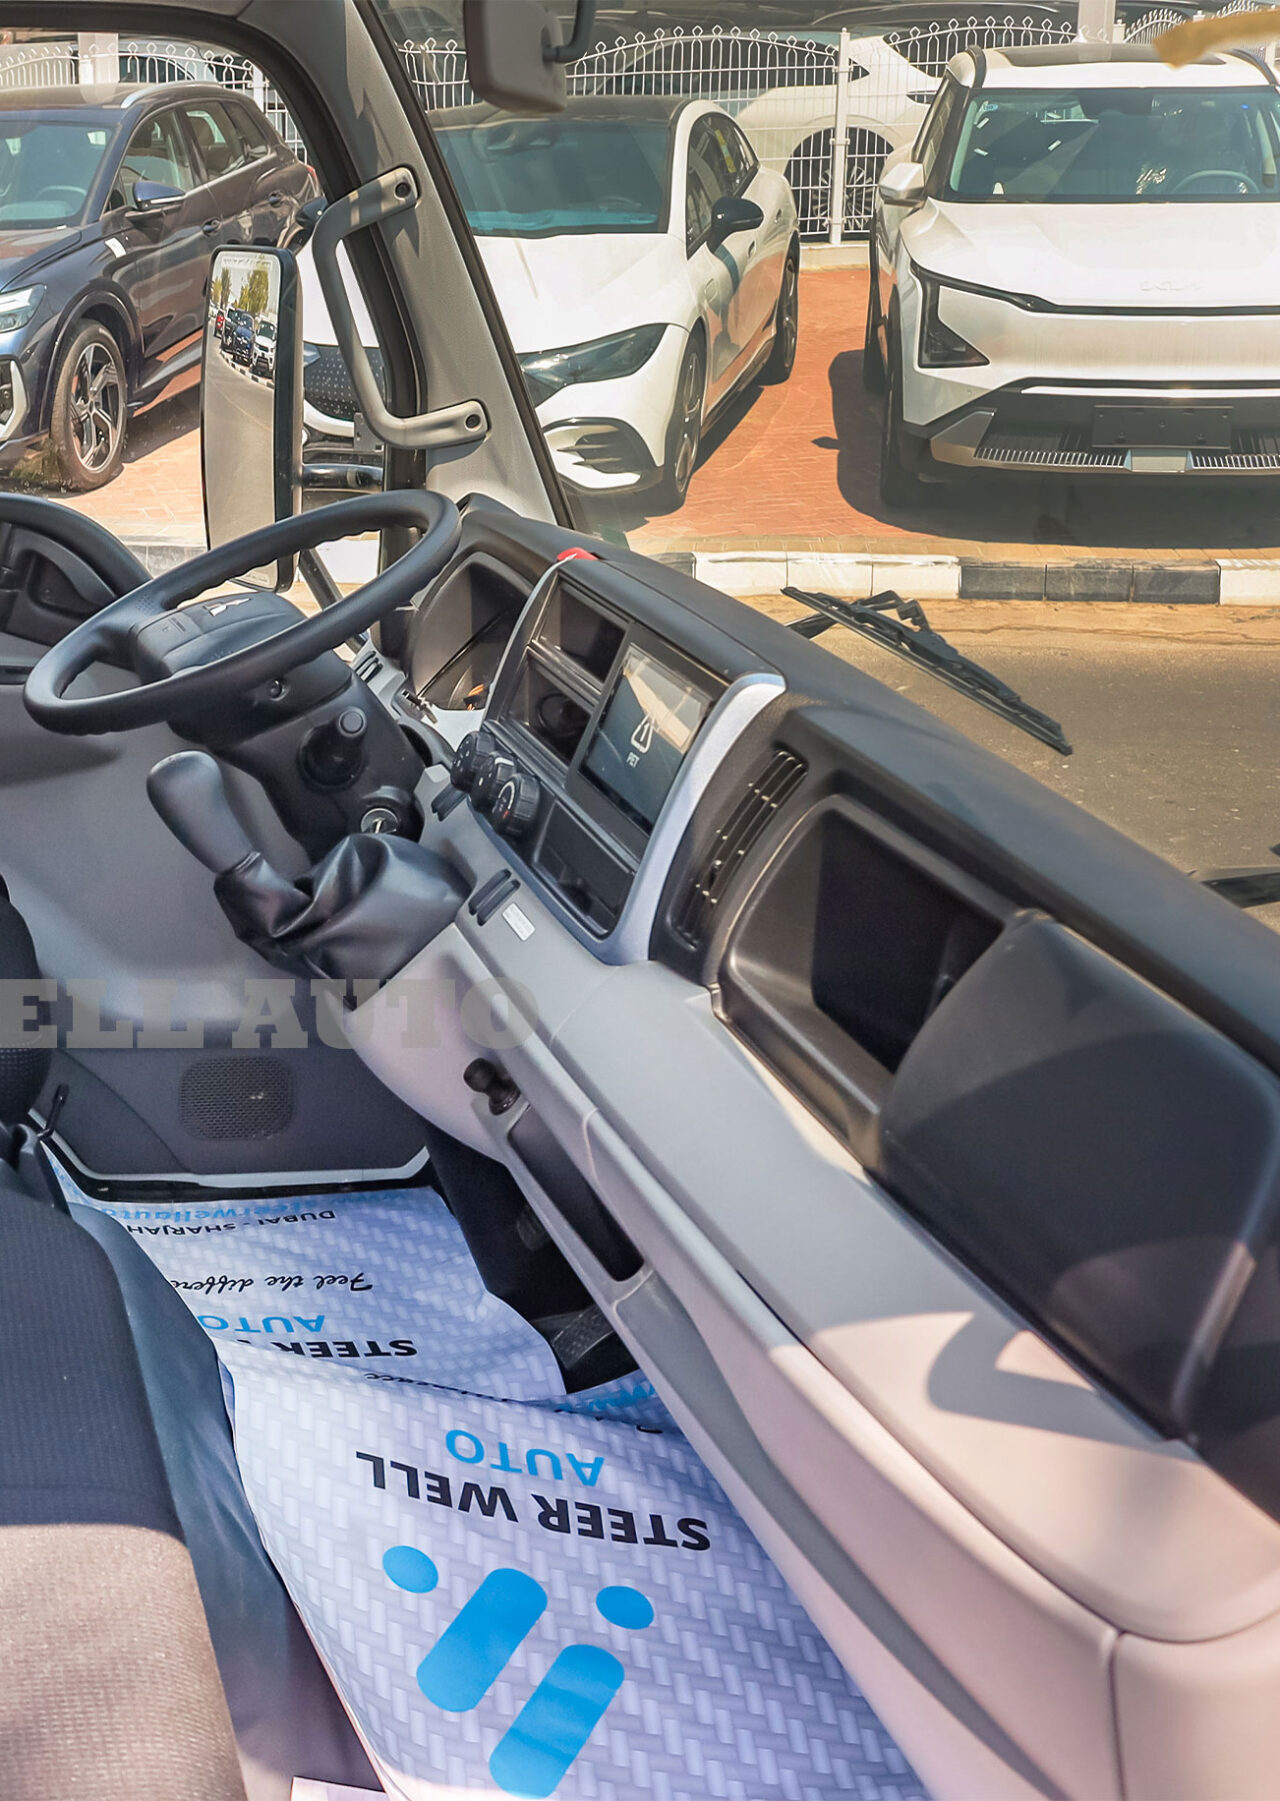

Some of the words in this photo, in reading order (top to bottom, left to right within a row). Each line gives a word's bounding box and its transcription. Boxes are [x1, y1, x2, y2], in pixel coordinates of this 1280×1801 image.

[258, 1210, 336, 1226] DUBAI
[128, 1222, 236, 1235] SHARJAH
[266, 1273, 304, 1291] the
[317, 1272, 374, 1292] Feel
[197, 1315, 325, 1333] AUTO
[445, 1429, 605, 1488] AUTO
[356, 1451, 519, 1523] WELL
[531, 1494, 711, 1551] STEER
